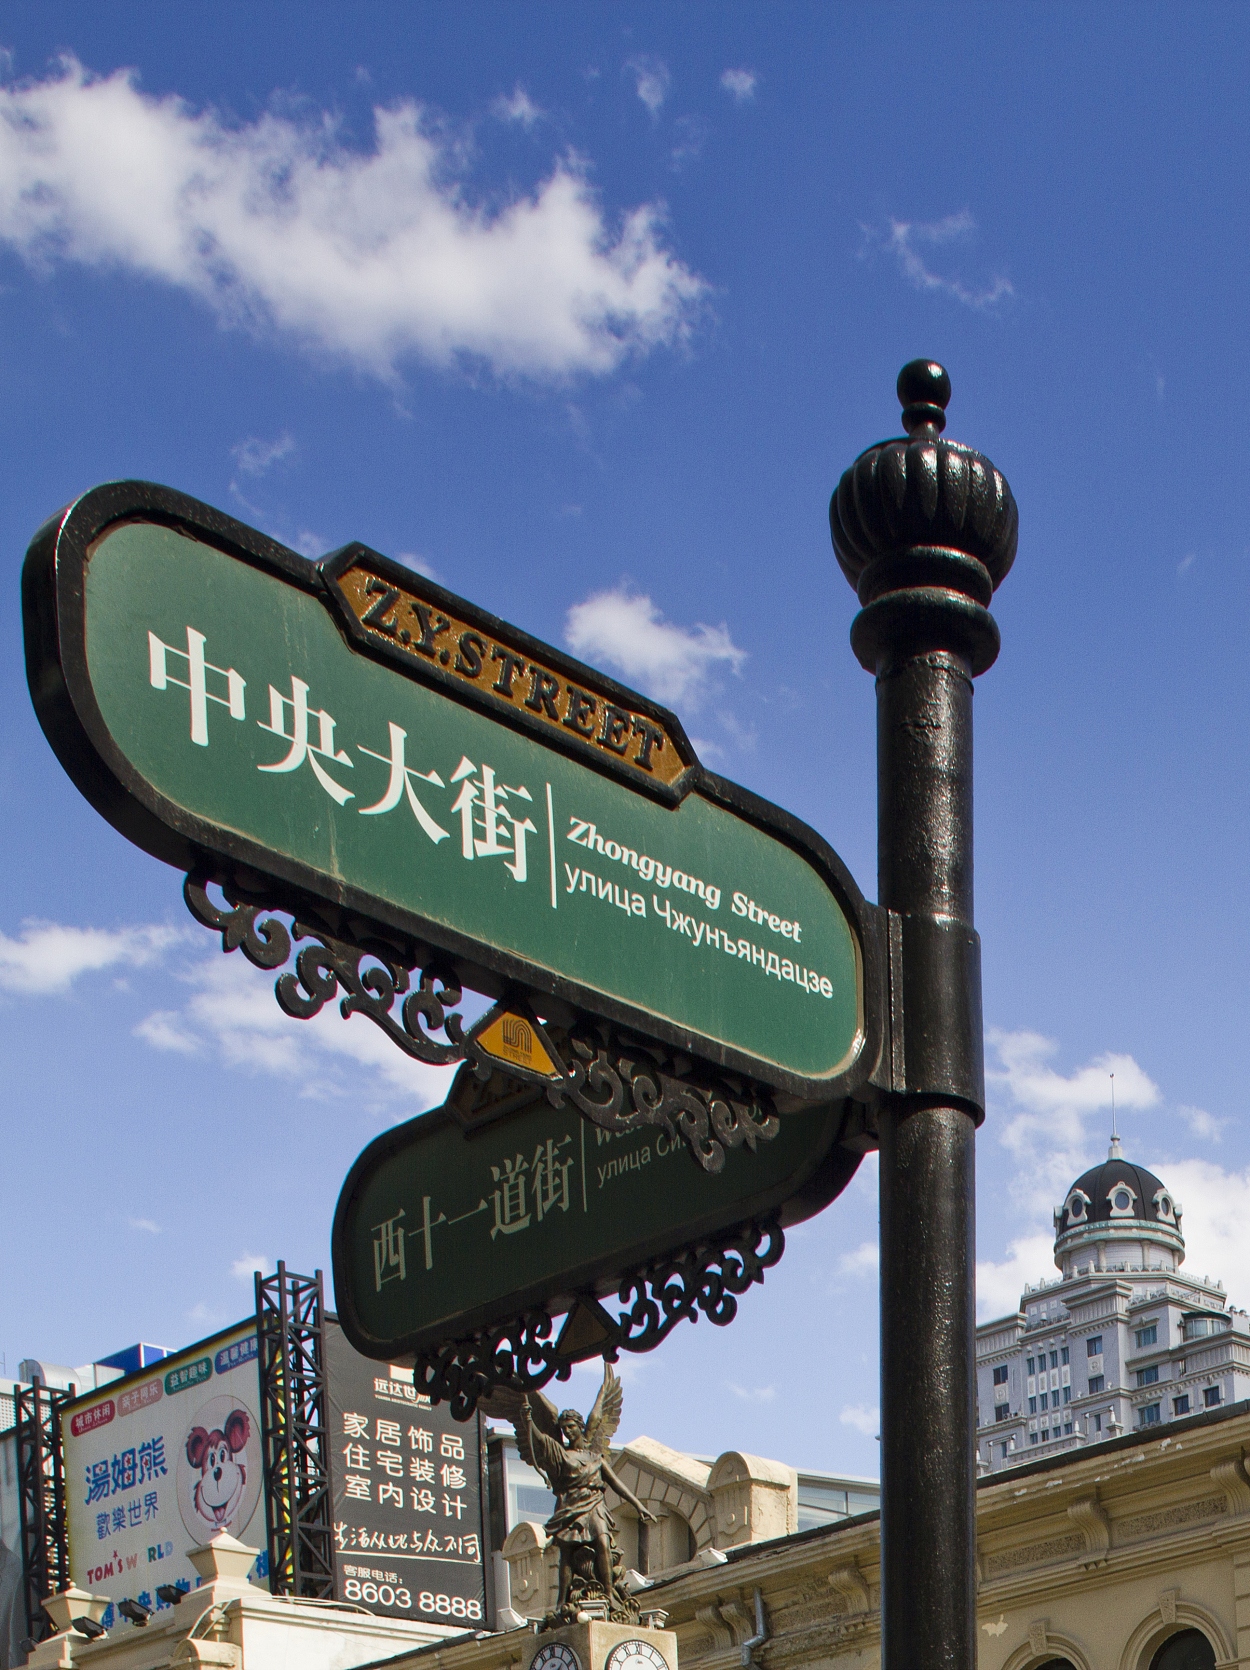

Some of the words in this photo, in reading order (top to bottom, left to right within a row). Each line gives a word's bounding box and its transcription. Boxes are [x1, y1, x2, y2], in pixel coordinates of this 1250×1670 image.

[361, 575, 664, 771] Z.Y.STREET
[148, 626, 538, 883] 中央大街
[566, 816, 721, 909] Zhongyang
[731, 891, 802, 943] Street
[564, 862, 647, 918] улица
[652, 894, 833, 998] Чжунъяндацзе
[597, 1146, 651, 1188] улица
[371, 1133, 575, 1293] 西十一道街
[75, 1404, 111, 1429] 城市休闲
[343, 1412, 465, 1460] 家居饰品
[85, 1436, 168, 1505] 湯姆熊
[343, 1443, 467, 1489] 住宅装修
[96, 1491, 159, 1539] 歡樂世界
[345, 1474, 467, 1519] 室内设计
[334, 1521, 481, 1563] 生活从此与众不同
[345, 1579, 412, 1608] 8603
[419, 1591, 482, 1620] 8888
